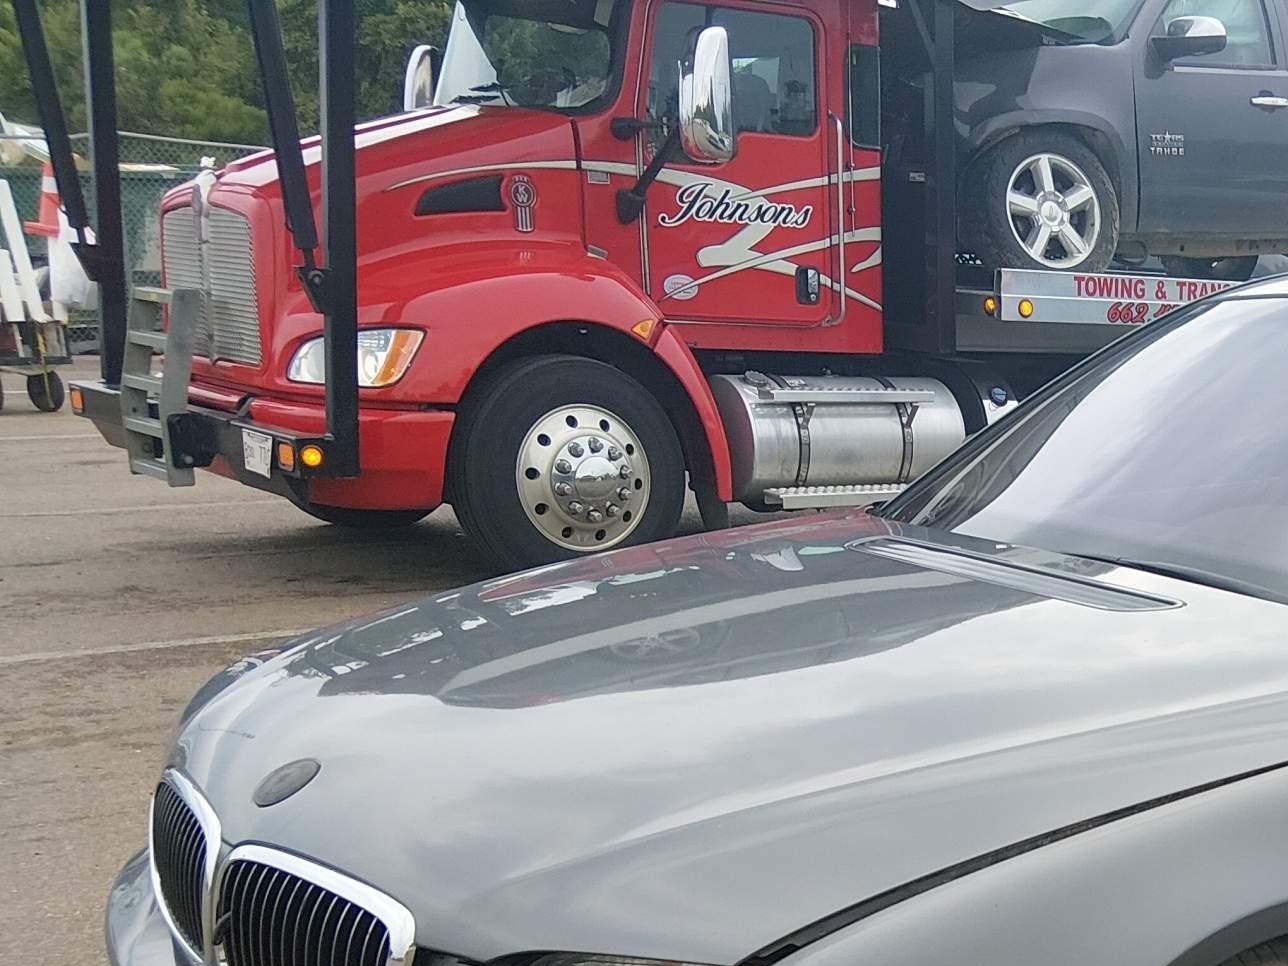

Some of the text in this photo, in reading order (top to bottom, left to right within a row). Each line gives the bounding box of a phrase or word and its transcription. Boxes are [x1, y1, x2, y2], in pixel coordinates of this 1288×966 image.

[659, 181, 813, 227] Johnsons
[1073, 275, 1232, 301] TOWING & TRAN
